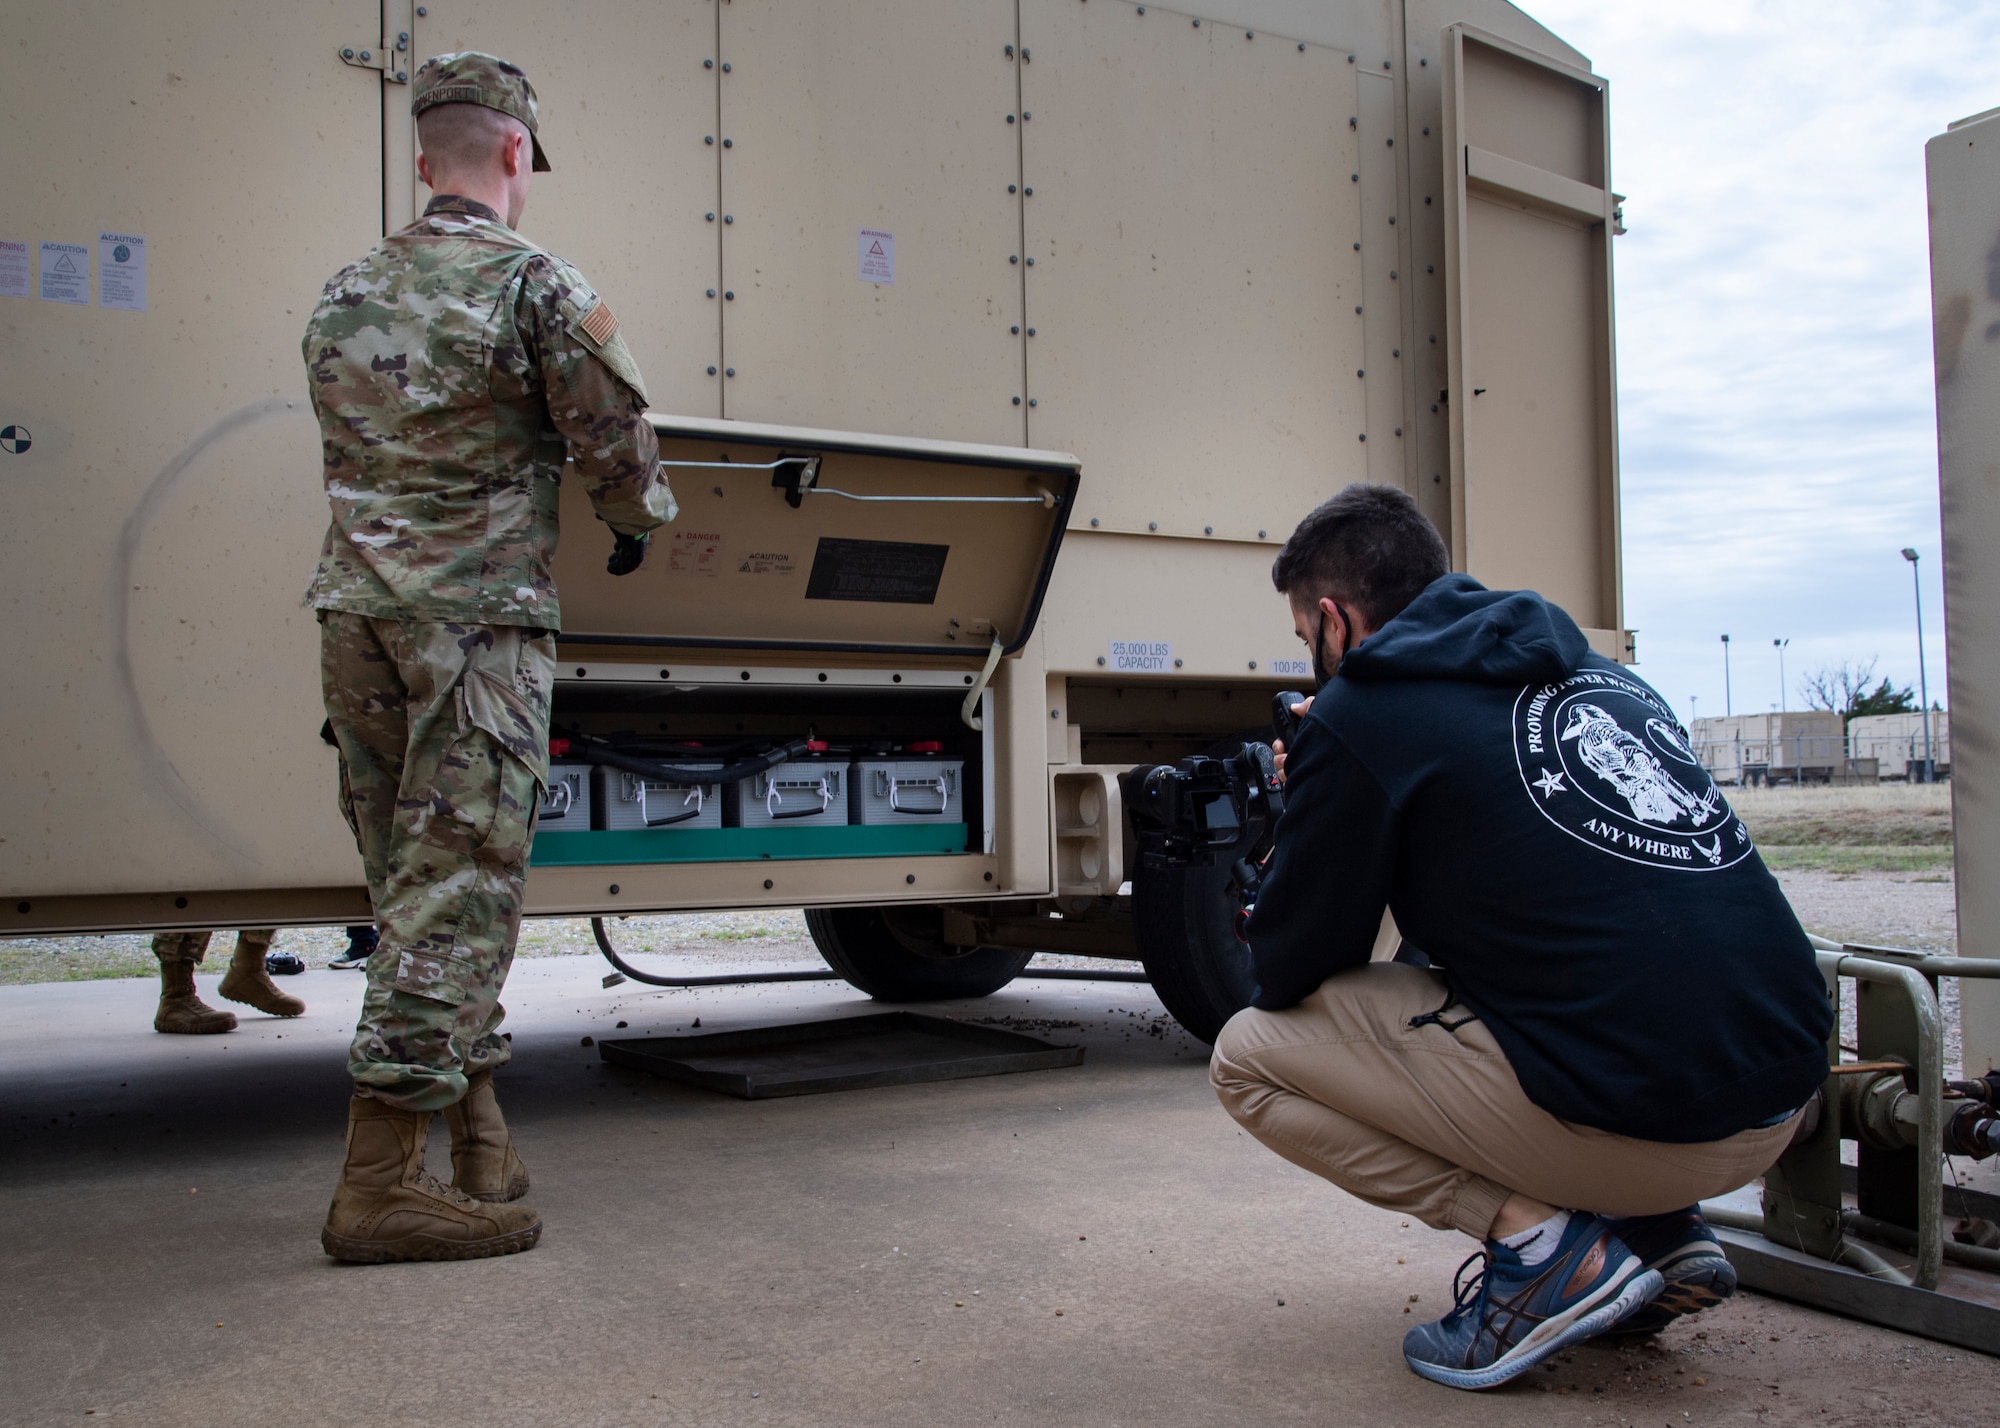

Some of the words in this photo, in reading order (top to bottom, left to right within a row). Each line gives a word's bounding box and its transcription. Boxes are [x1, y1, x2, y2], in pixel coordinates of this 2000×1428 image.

[108, 234, 144, 245] CAUTION
[865, 230, 893, 240] WARNING
[50, 243, 88, 255] CAUTION
[686, 532, 720, 542] DANGER
[754, 552, 789, 562] CAUTION
[1112, 642, 1147, 656] 25,000
[1149, 643, 1169, 656] LBS
[1118, 656, 1164, 670] CAPACITY
[1273, 661, 1290, 673] 100
[1292, 662, 1307, 673] PSI
[1527, 683, 1558, 754] PROVIDING
[1627, 833, 1692, 860] WHERE
